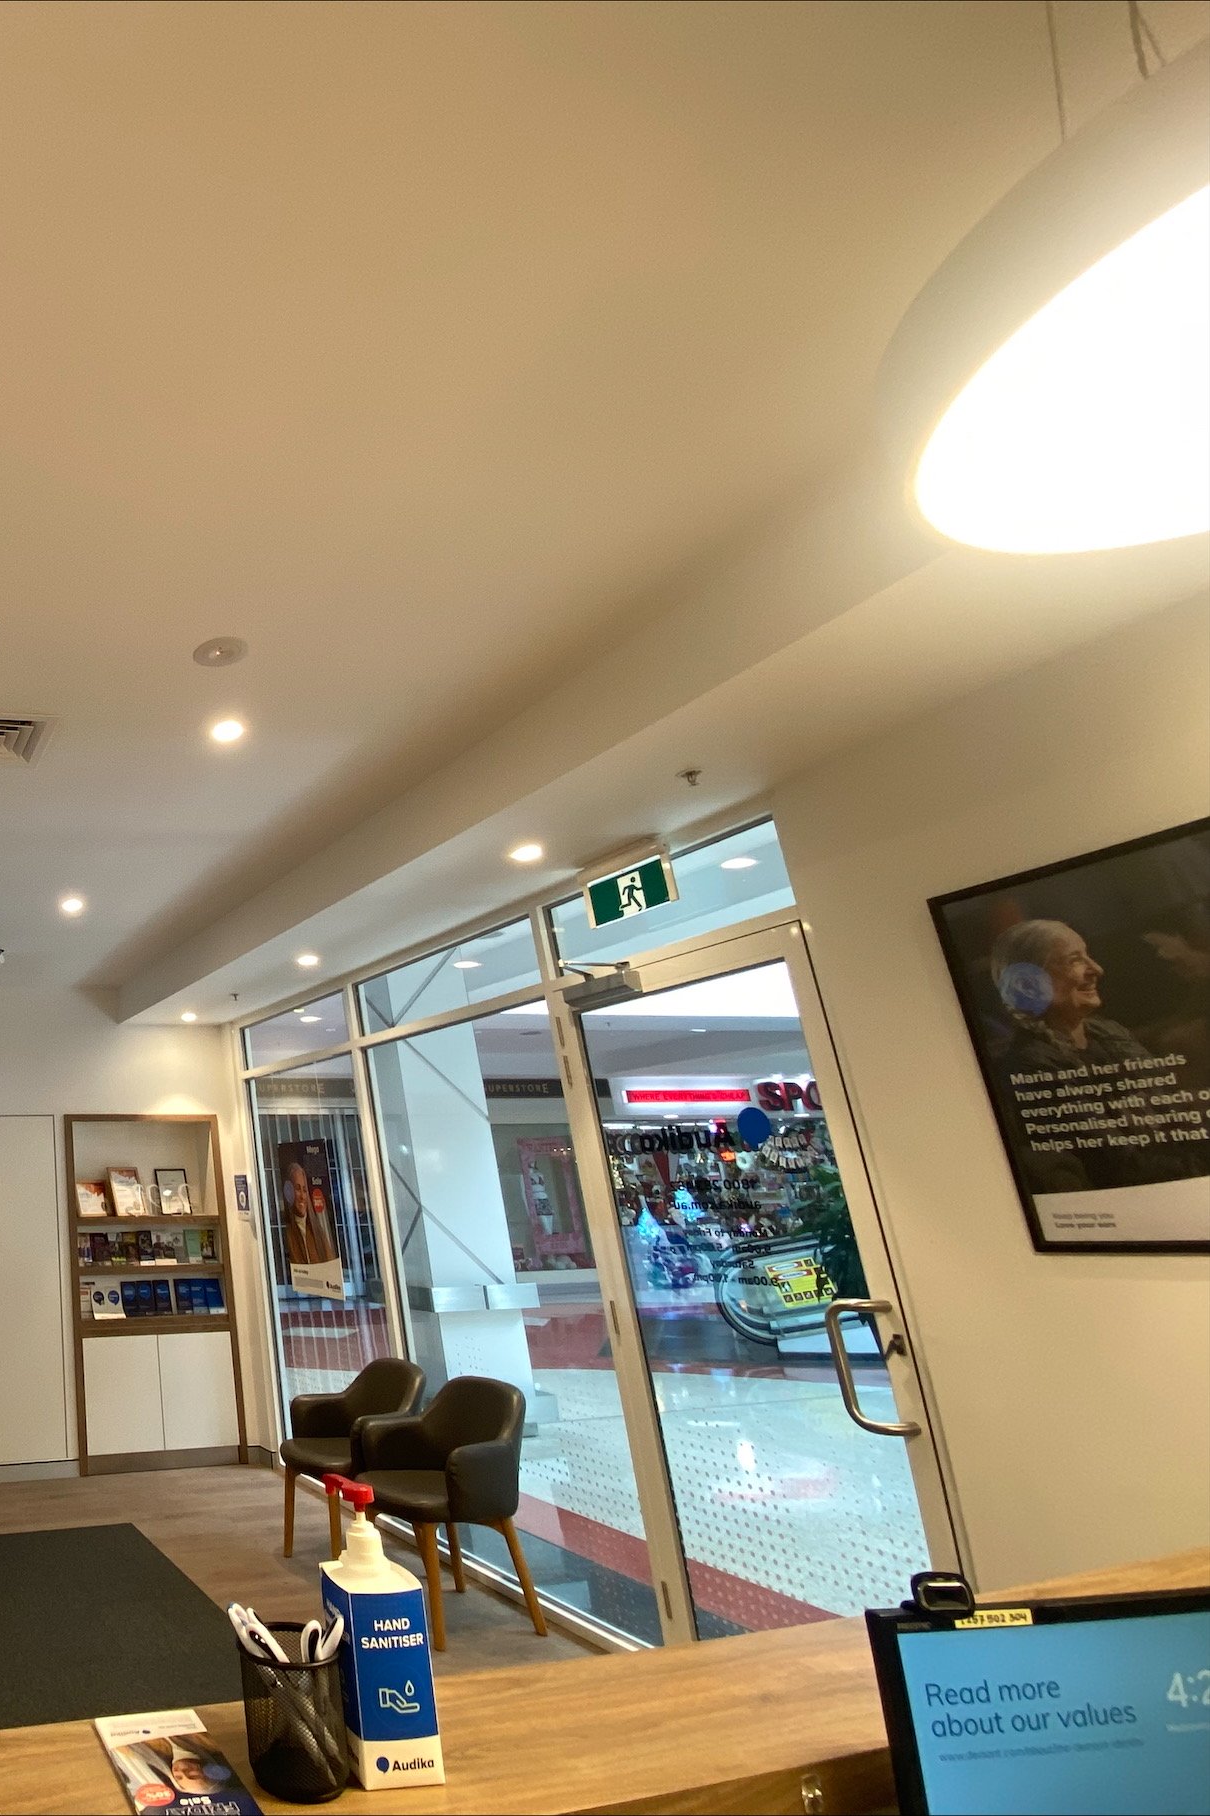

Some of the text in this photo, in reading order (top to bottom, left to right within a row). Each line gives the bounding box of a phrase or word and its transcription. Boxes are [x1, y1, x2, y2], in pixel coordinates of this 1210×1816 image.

[1010, 1053, 1187, 1085] Maria and her friends
[488, 1083, 550, 1094] UPERSTORE
[1015, 1072, 1177, 1102] have always shared
[1021, 1099, 1105, 1118] everything
[1108, 1095, 1145, 1110] with
[1150, 1089, 1193, 1106] each
[1025, 1114, 1128, 1135] Personalised
[1131, 1108, 1202, 1127] hearing
[1030, 1126, 1208, 1153] helps her keep it that
[373, 1617, 411, 1632] HAND
[960, 1615, 985, 1625] 57
[361, 1632, 424, 1650] SANITISER
[925, 1678, 1061, 1707] Read more
[931, 1712, 1005, 1738] about
[1011, 1712, 1050, 1732] our
[1056, 1702, 1138, 1727] values
[391, 1756, 435, 1773] Audika
